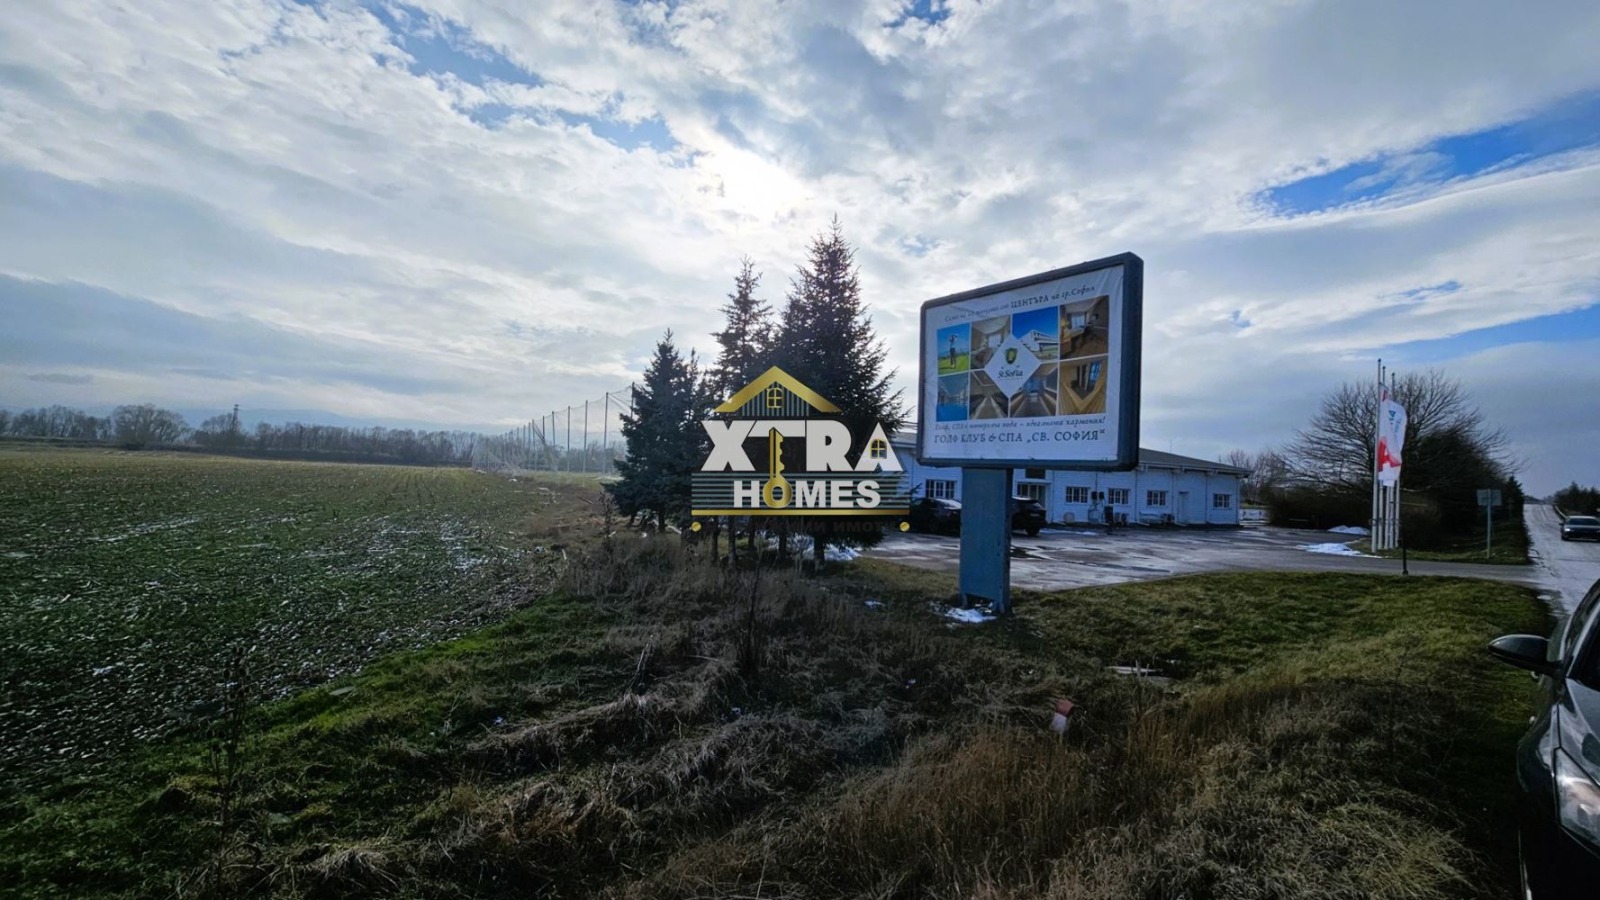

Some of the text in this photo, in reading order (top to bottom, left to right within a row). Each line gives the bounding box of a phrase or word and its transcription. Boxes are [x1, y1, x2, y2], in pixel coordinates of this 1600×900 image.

[1011, 295, 1049, 308] ЦЕНТЪРА
[934, 434, 958, 443] ГОЛФ
[961, 433, 986, 442] КЛУБ
[998, 432, 1023, 442] СПА
